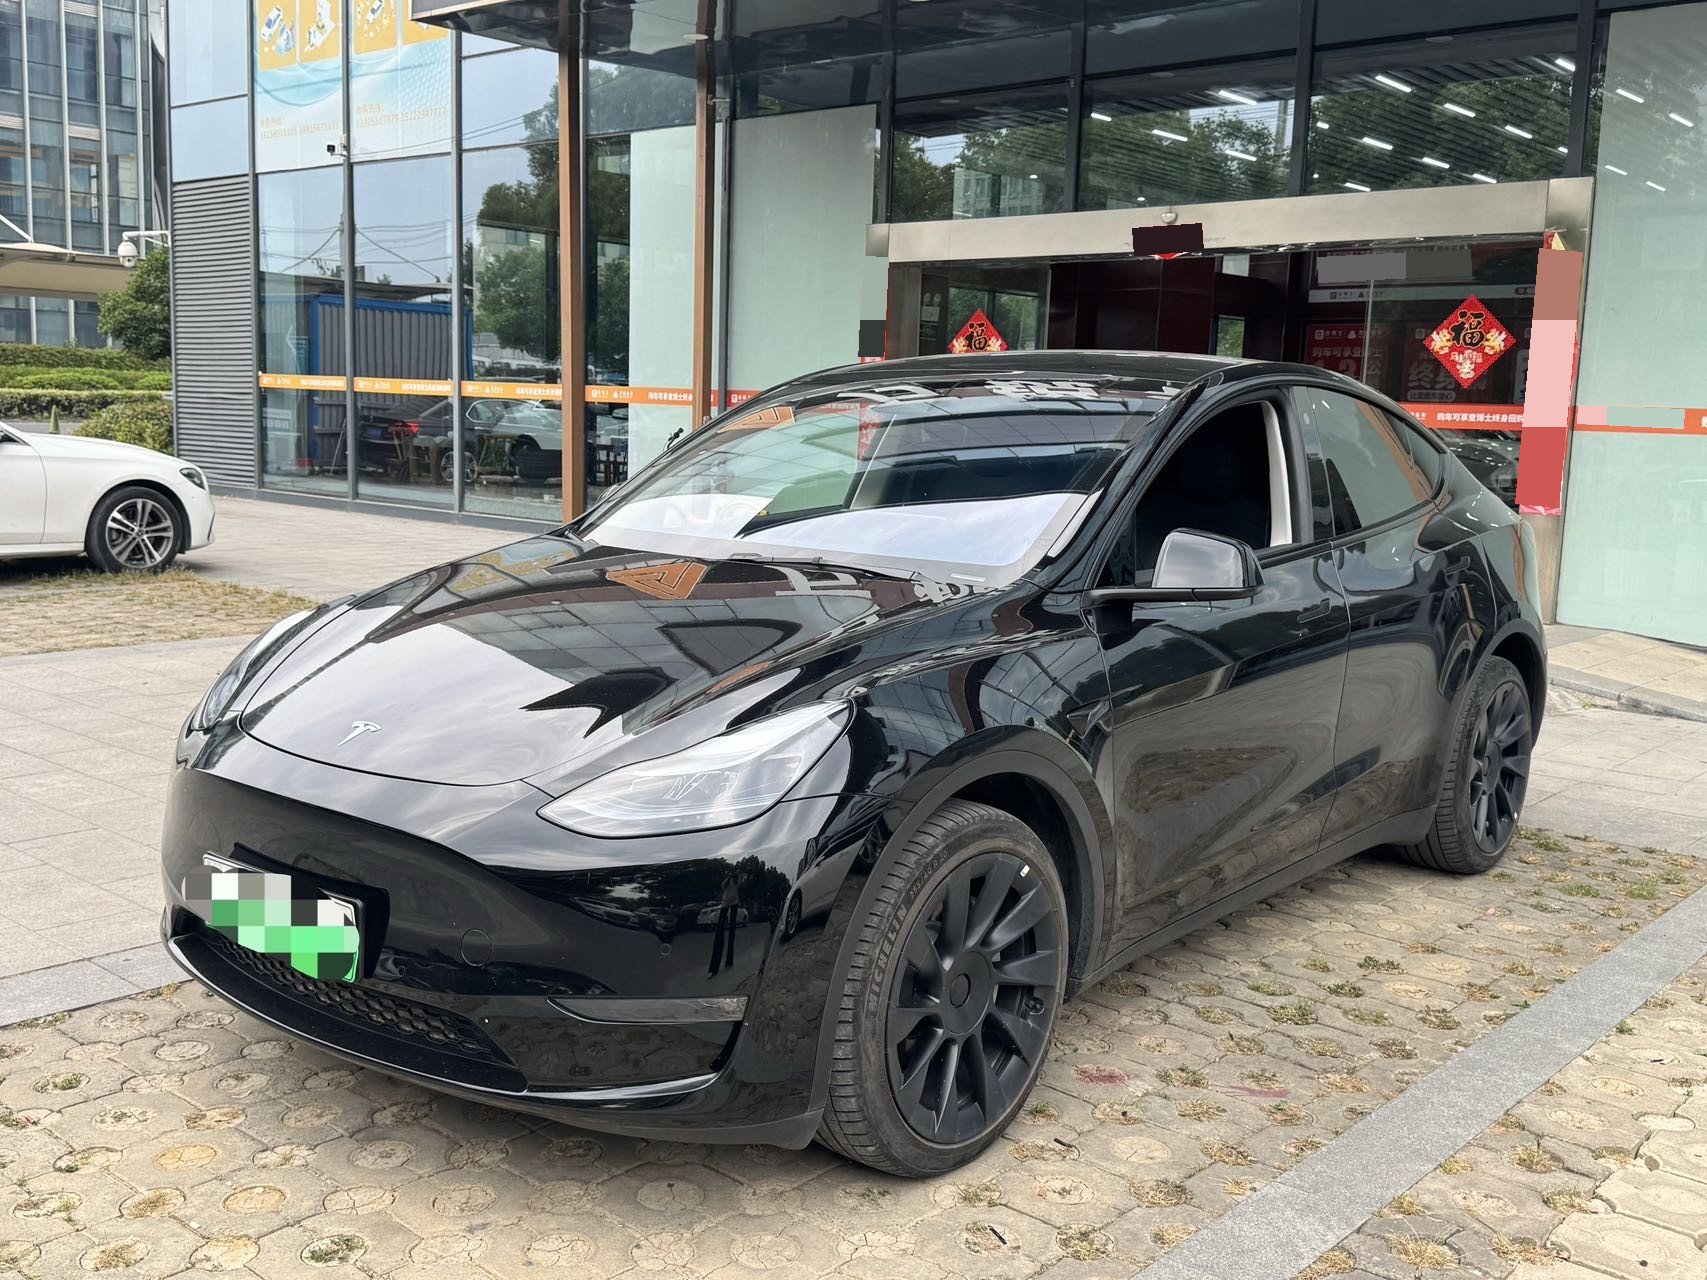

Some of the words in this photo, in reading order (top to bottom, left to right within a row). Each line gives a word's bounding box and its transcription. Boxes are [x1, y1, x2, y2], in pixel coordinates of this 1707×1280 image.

[964, 321, 988, 351] 福
[1449, 310, 1486, 349] 福
[867, 903, 908, 1014] MICHELIN
